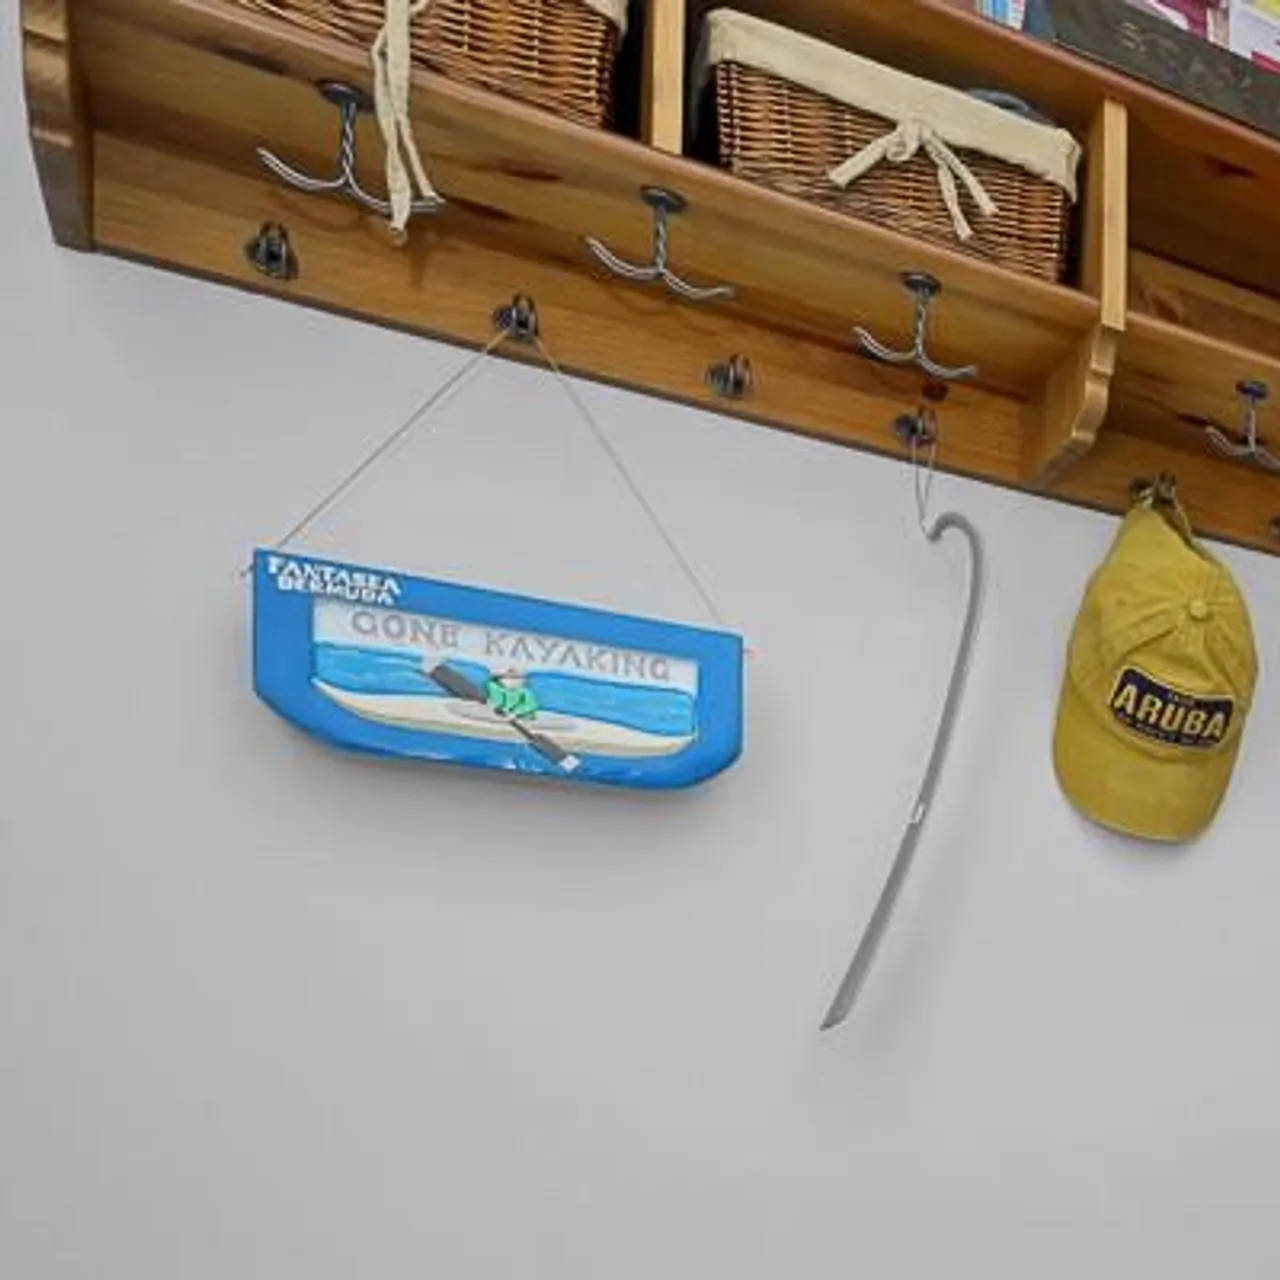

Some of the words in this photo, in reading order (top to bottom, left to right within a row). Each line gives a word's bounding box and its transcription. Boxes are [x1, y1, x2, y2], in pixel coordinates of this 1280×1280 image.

[268, 556, 402, 597] FANTASEA
[277, 575, 396, 606] BERMUDA
[351, 610, 462, 649] GONE
[485, 631, 670, 683] KAYAKING
[1114, 684, 1225, 737] ARUBA
